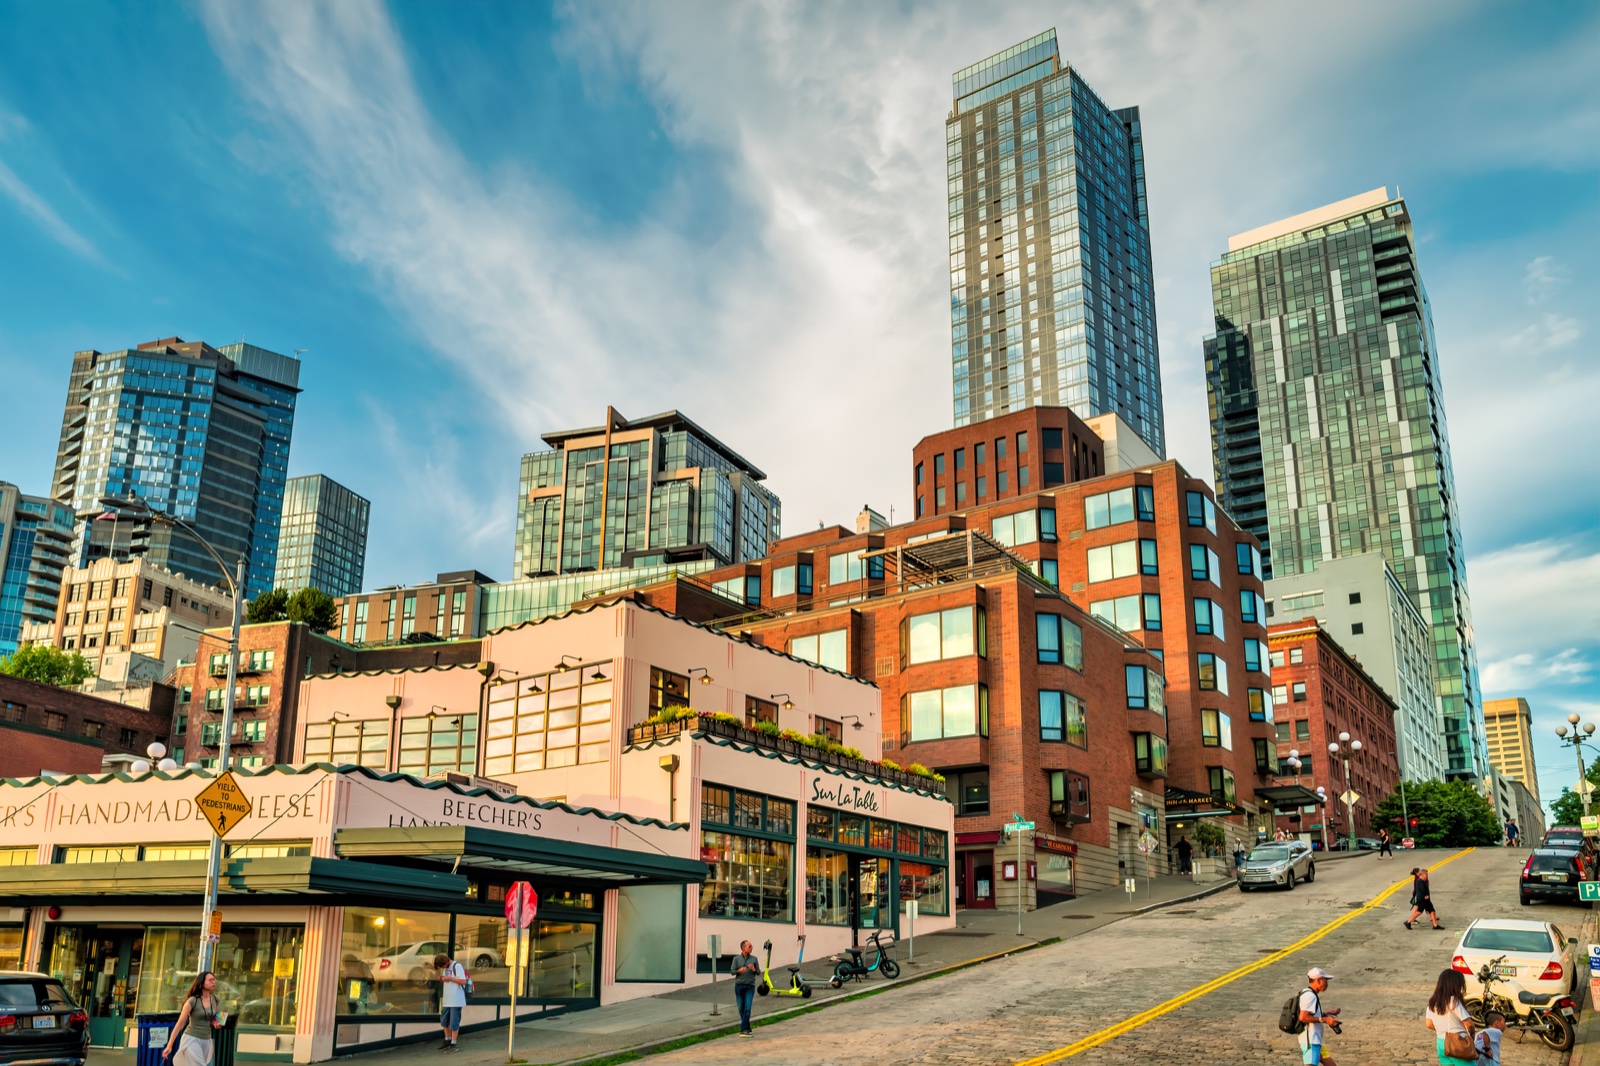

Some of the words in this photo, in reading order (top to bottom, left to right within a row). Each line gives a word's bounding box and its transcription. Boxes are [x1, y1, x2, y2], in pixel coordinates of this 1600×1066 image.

[217, 782, 236, 793] YIELD
[221, 792, 230, 801] TO
[811, 777, 836, 802] Sur
[837, 783, 852, 807] La
[853, 786, 879, 812] Table
[201, 798, 246, 813] PEDESTRIANS
[443, 798, 542, 831] BEECHER'S
[0, 804, 36, 828] R'S
